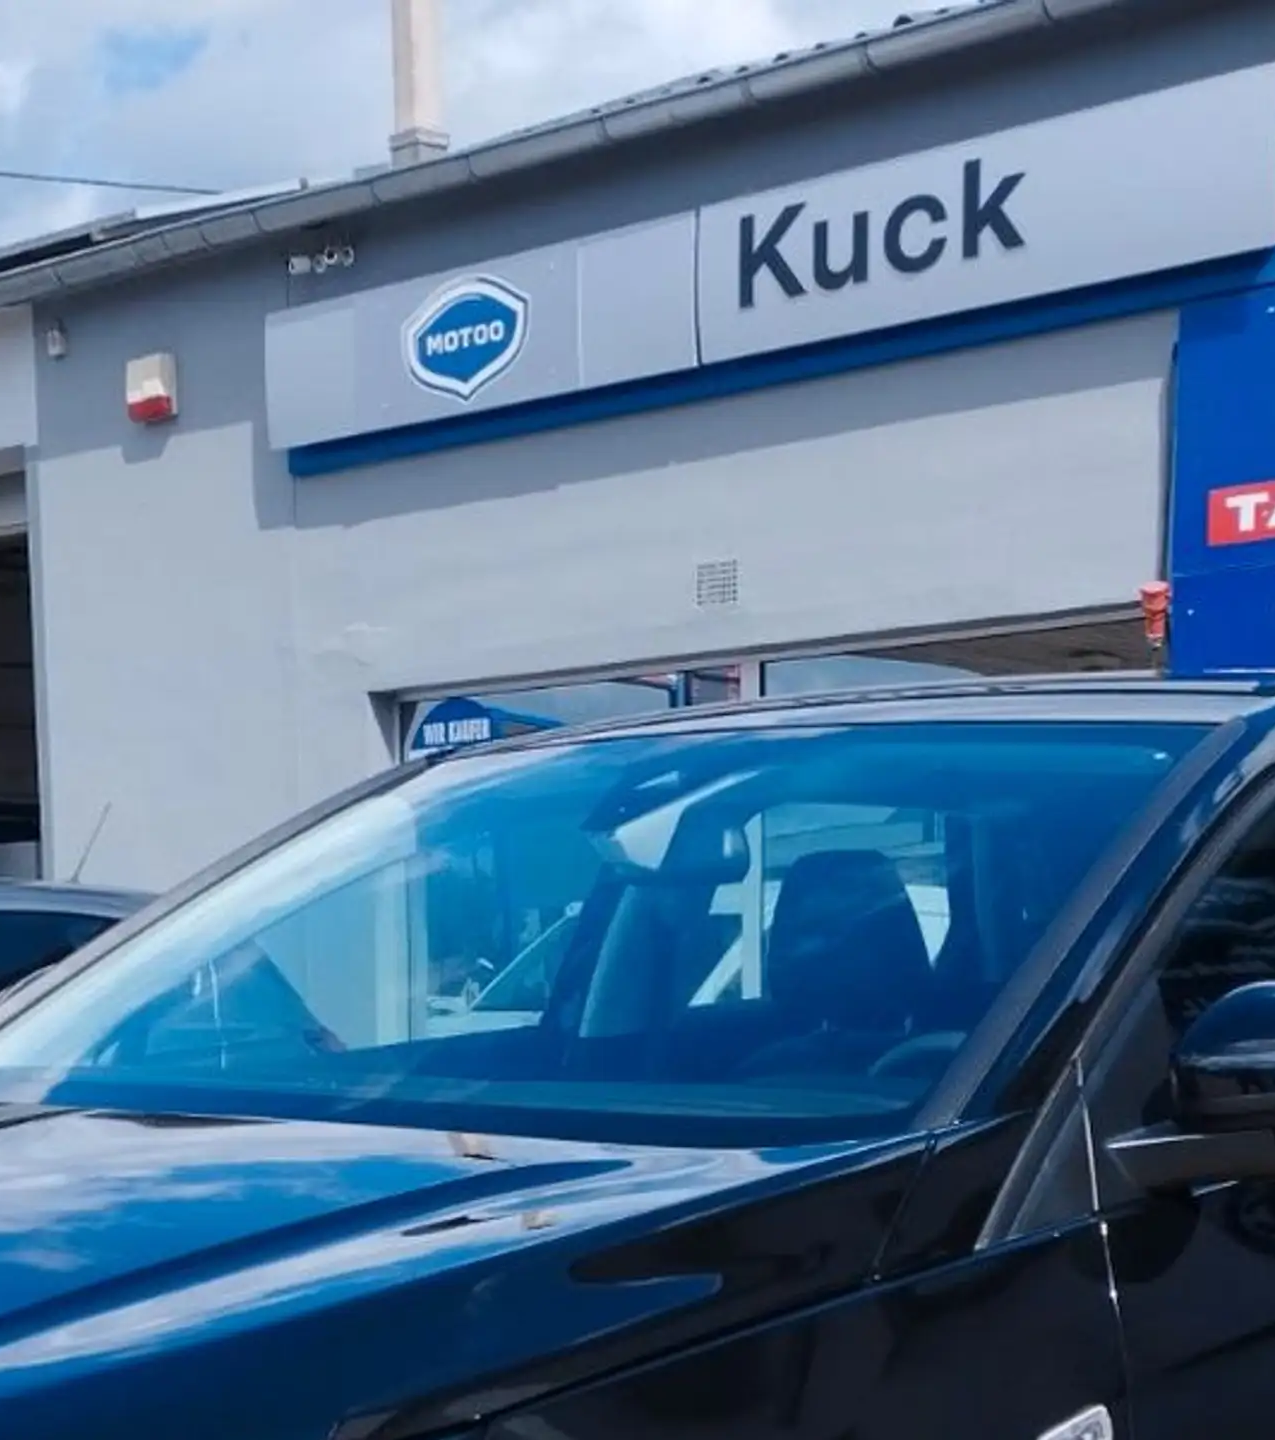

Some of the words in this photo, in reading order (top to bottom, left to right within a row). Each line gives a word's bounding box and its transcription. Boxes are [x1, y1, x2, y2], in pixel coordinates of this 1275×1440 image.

[737, 160, 1026, 308] Kuck
[426, 320, 505, 356] MOTOO
[423, 722, 446, 745] WIR
